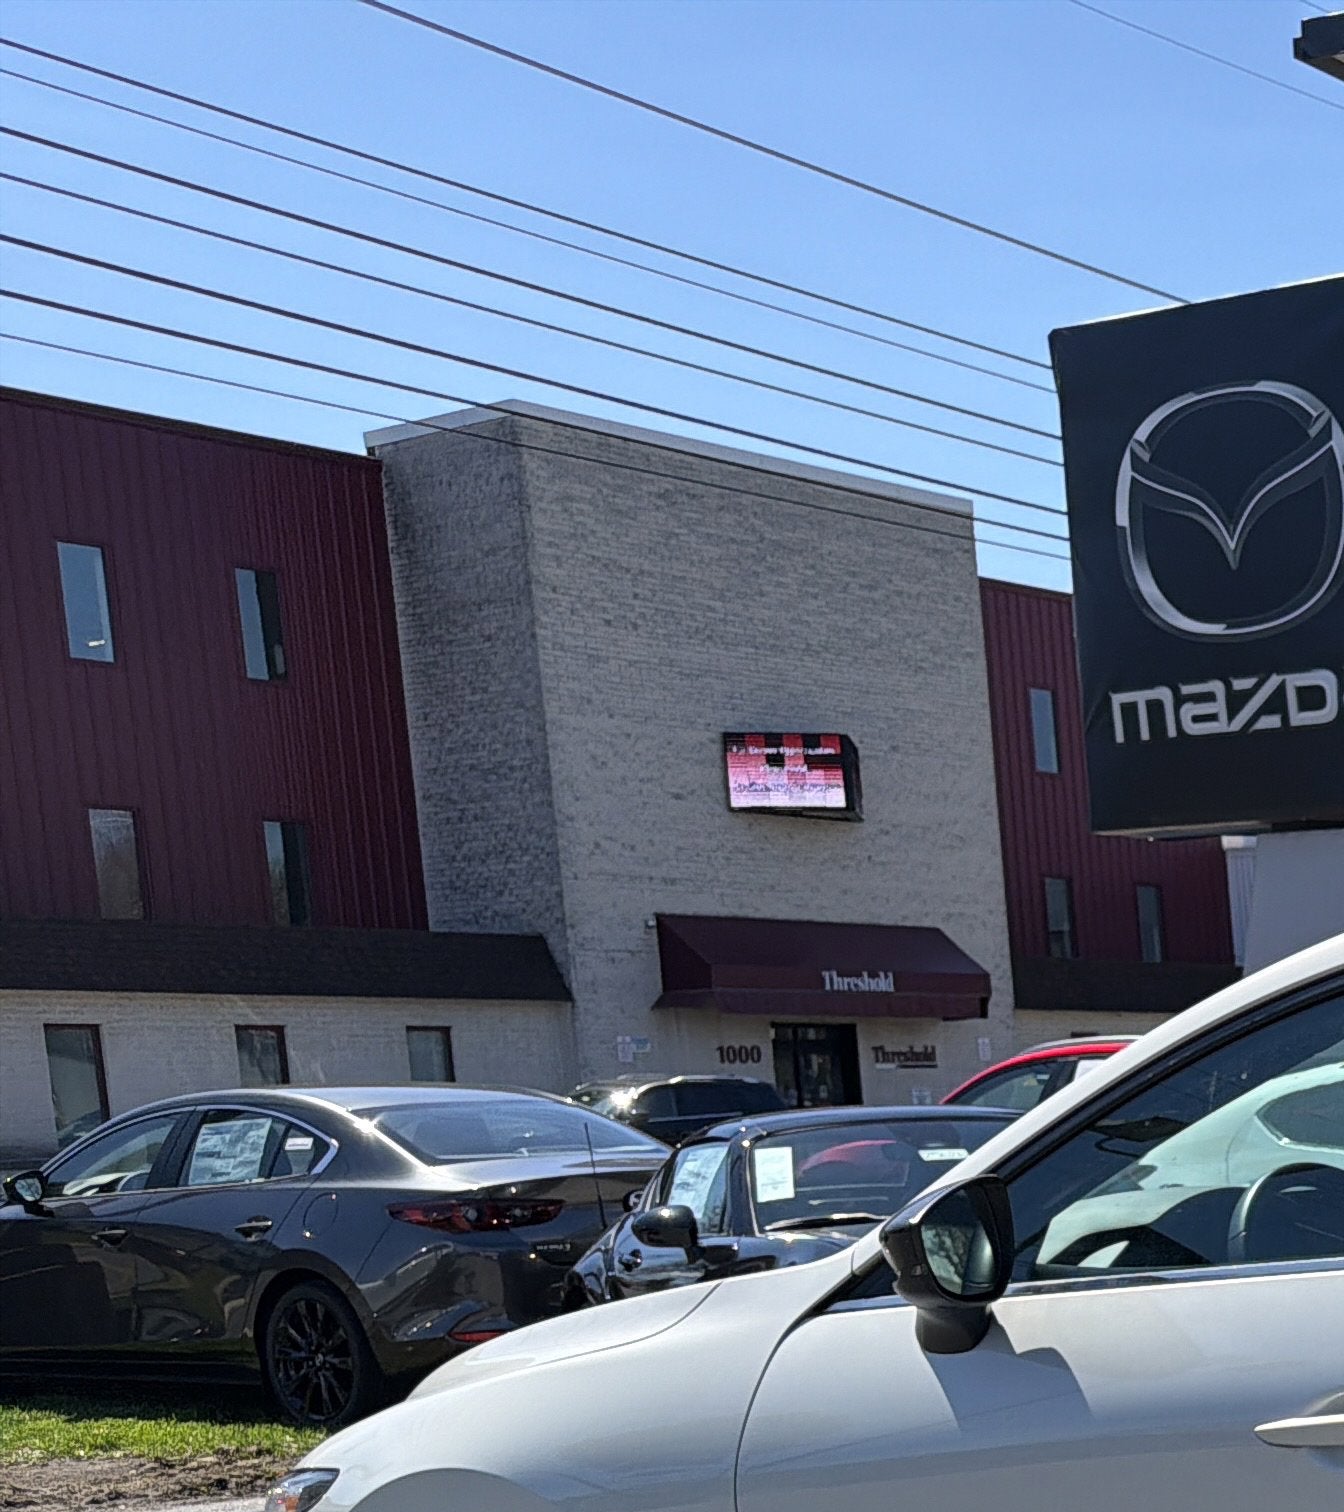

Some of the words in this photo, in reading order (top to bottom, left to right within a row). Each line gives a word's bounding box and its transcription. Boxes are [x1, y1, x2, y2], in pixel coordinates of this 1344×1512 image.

[821, 970, 895, 992] Threshold
[716, 1045, 762, 1064] 1000
[872, 1044, 937, 1063] Threshold
